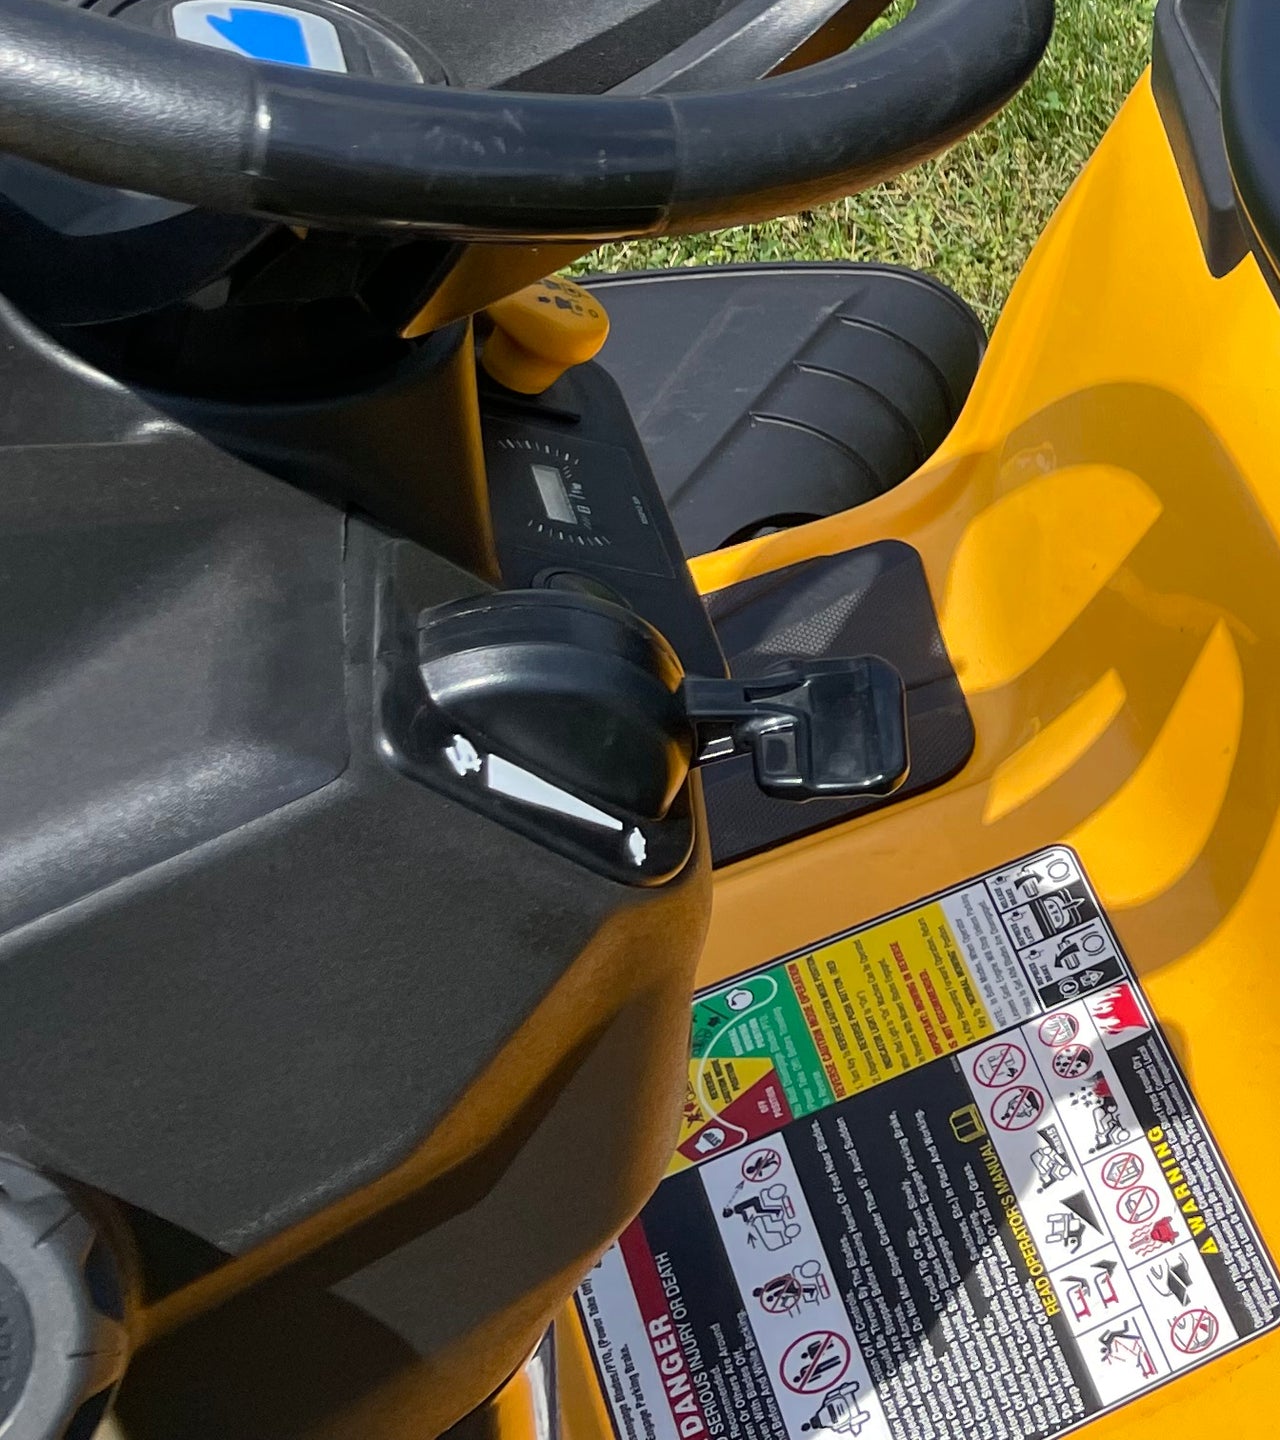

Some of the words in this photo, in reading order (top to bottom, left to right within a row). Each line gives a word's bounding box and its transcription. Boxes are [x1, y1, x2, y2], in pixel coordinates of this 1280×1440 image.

[808, 1119, 828, 1152] Blades.
[885, 1109, 905, 1139] Brake,
[912, 1107, 936, 1146] Working.
[819, 1150, 836, 1173] Near
[896, 1137, 918, 1171] Parking
[927, 1144, 943, 1163] And
[977, 1138, 1010, 1195] MANUAL
[827, 1171, 843, 1192] Feet
[909, 1169, 931, 1204] Engage
[934, 1162, 952, 1188] Place
[1145, 1124, 1207, 1236] WARNING
[834, 1191, 848, 1204] Or
[899, 1177, 919, 1209] Slowly.
[944, 1186, 956, 1198] In
[947, 1195, 965, 1218] Etc.)
[839, 1203, 858, 1233] Hands
[911, 1208, 929, 1235] Down
[922, 1202, 944, 1237] Blades,
[966, 1209, 988, 1244] Storing.
[836, 1233, 857, 1268] Blades.
[850, 1231, 871, 1266] Placing
[903, 1225, 920, 1247] Slip.
[921, 1234, 938, 1259] Back
[956, 1217, 981, 1260] Switches,
[980, 1244, 993, 1258] Or
[999, 1193, 1044, 1277] OPERATOR'S
[911, 1246, 925, 1260] Or
[916, 1258, 931, 1275] Tip
[935, 1235, 962, 1283] Disengage
[653, 1250, 680, 1297] DEATH
[849, 1267, 864, 1286] The
[862, 1265, 883, 1297] Before
[922, 1273, 941, 1303] Could
[929, 1257, 950, 1290] Blades
[973, 1259, 996, 1297] Shields,
[984, 1255, 1007, 1290] Fueling
[855, 1285, 869, 1299] By
[933, 1301, 944, 1310] It
[942, 1288, 959, 1312] Stop
[953, 1281, 978, 1323] Position,
[998, 1288, 1019, 1321] Before
[1033, 1275, 1061, 1316] READ
[668, 1296, 688, 1321] OR
[860, 1298, 882, 1334] Thrown
[873, 1295, 897, 1335] Stopped
[980, 1312, 997, 1336] Key.
[987, 1295, 1012, 1336] (Guards,
[709, 1321, 729, 1358] Around
[734, 1308, 756, 1350] Backing.
[873, 1333, 887, 1348] Be
[936, 1309, 957, 1342] Where
[950, 1310, 971, 1342] Uphill,
[1010, 1319, 1028, 1344] Cool
[675, 1319, 705, 1372] INJURY
[732, 1346, 746, 1366] Off.
[888, 1334, 904, 1353] Are
[962, 1339, 982, 1371] Going
[969, 1321, 997, 1372] Operator's
[988, 1334, 1012, 1374] Remove
[1003, 1334, 1027, 1374] Devices
[1020, 1342, 1034, 1357] To
[647, 1312, 704, 1438] DANGER
[721, 1356, 735, 1375] Are
[747, 1348, 765, 1376] While
[878, 1347, 898, 1377] Could
[894, 1351, 916, 1387] Engine
[947, 1339, 972, 1382] Machine
[1025, 1355, 1050, 1397] Machine
[726, 1374, 747, 1409] Others
[738, 1365, 757, 1399] Blades
[756, 1375, 772, 1397] And
[889, 1375, 910, 1408] Which
[907, 1384, 924, 1407] And
[973, 1368, 993, 1399] Stops
[988, 1370, 1012, 1410] Leaving
[1003, 1372, 1020, 1394] And
[1018, 1371, 1039, 1405] Safety
[692, 1370, 726, 1436] SERIOUS
[709, 1364, 741, 1438] Recommended.
[738, 1407, 751, 1422] Or
[749, 1398, 765, 1422] With
[763, 1395, 783, 1430] Before
[963, 1380, 987, 1421] Operate
[1011, 1392, 1026, 1411] Off
[1041, 1395, 1061, 1425] Allow
[914, 1404, 937, 1440] Blades
[948, 1417, 966, 1440] xtra
[978, 1418, 995, 1440] Not
[984, 1397, 1009, 1440] Machine
[1018, 1409, 1036, 1435] Shut
[1030, 1403, 1050, 1431] Keep
